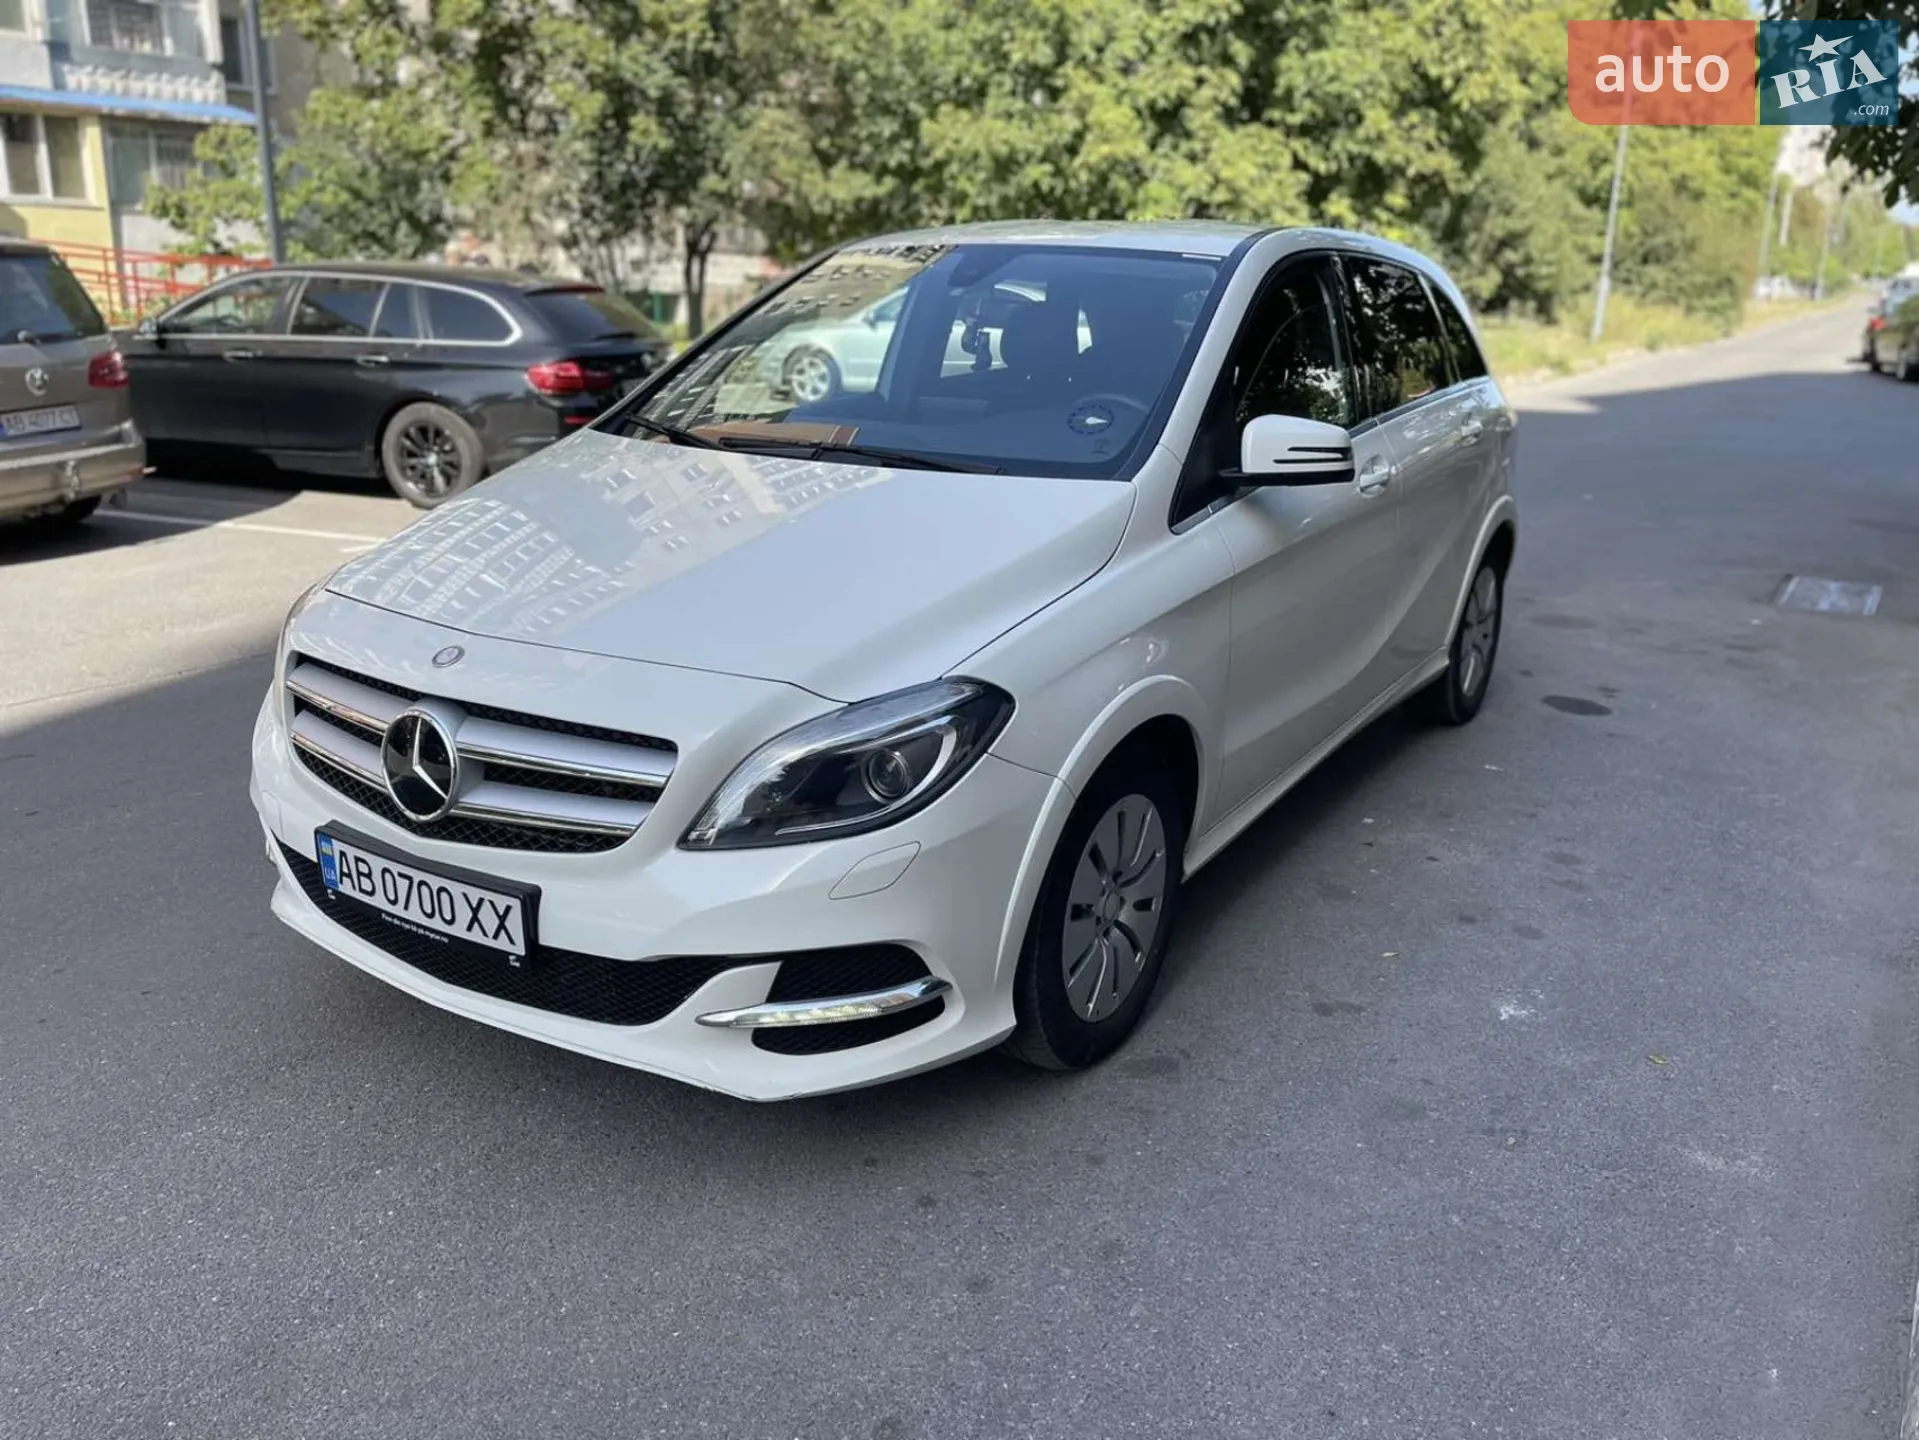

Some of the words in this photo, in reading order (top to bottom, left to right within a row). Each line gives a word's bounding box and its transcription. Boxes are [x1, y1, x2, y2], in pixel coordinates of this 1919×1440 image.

[339, 850, 376, 897] AB
[381, 866, 456, 926] 0700
[462, 891, 516, 946] XX
